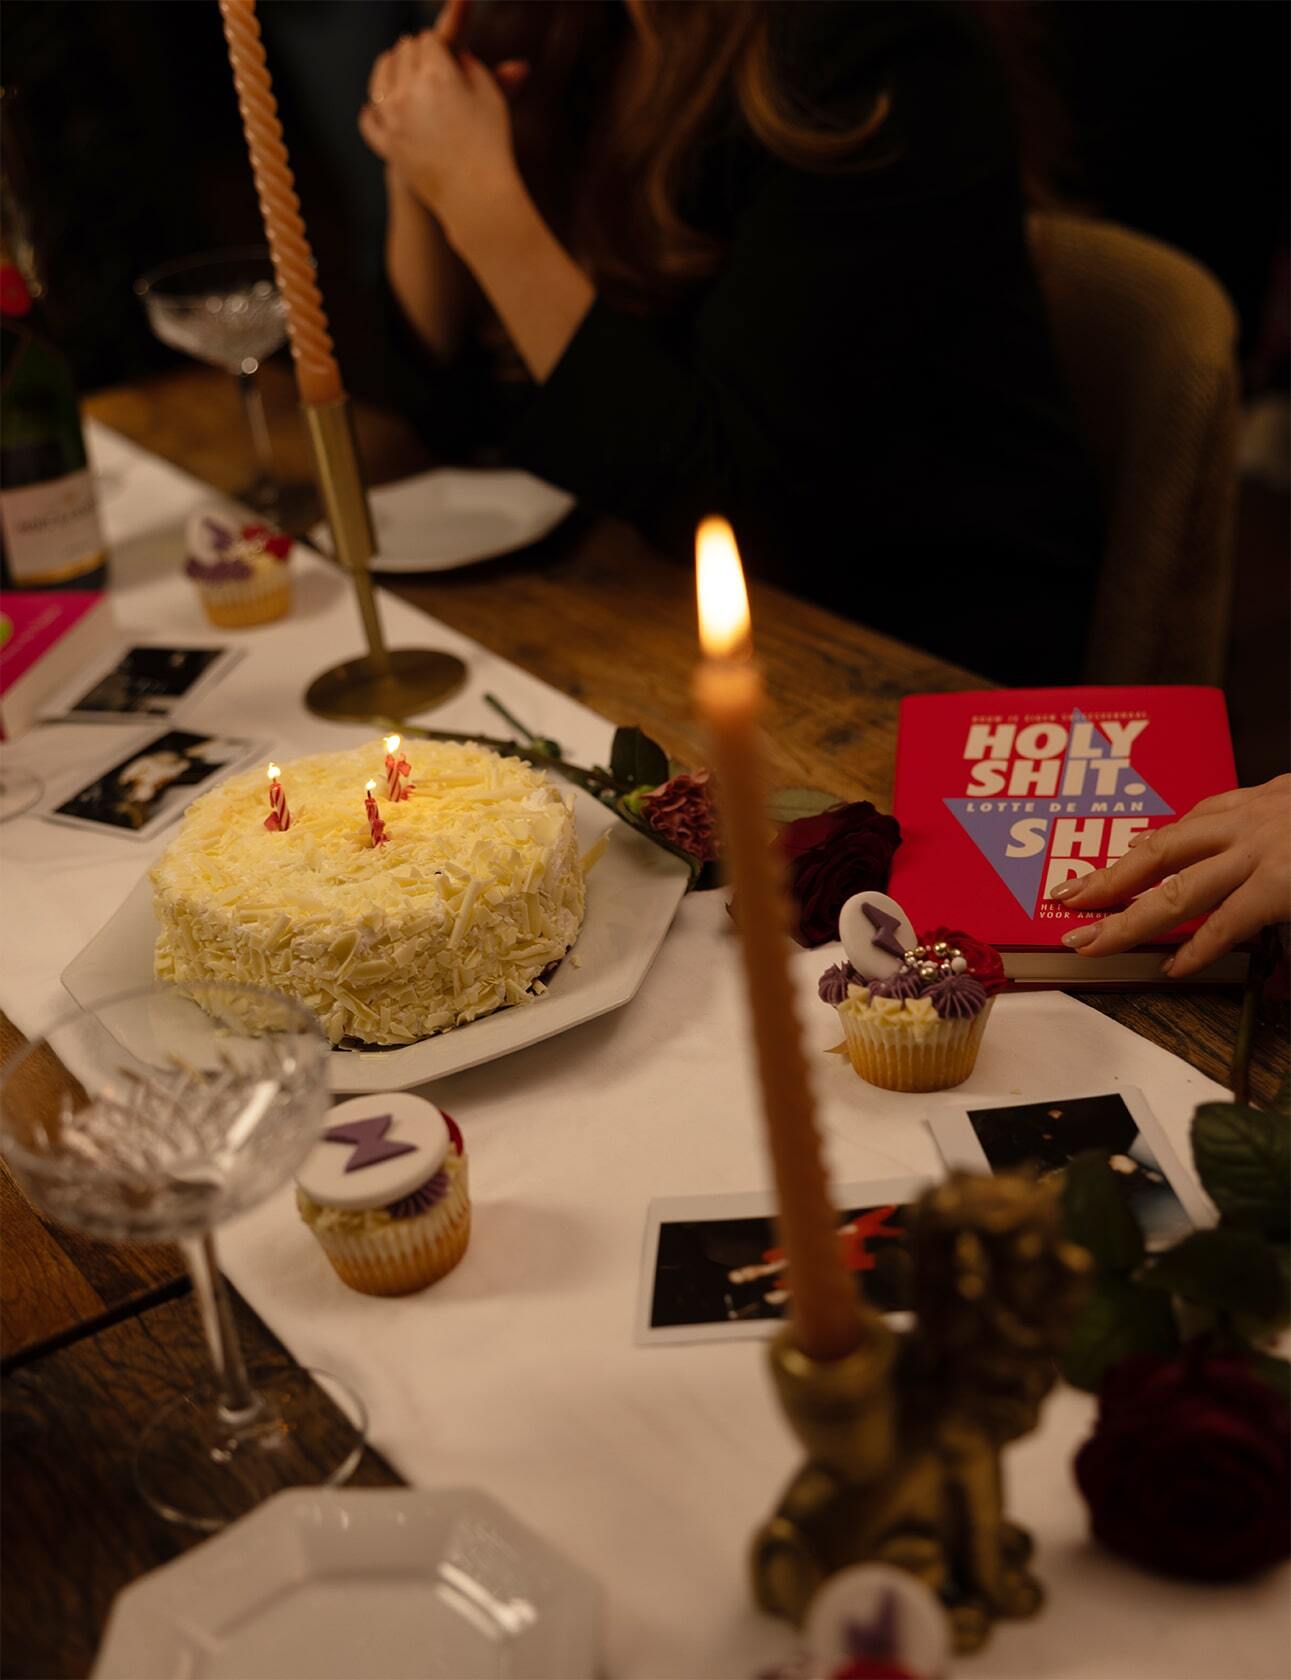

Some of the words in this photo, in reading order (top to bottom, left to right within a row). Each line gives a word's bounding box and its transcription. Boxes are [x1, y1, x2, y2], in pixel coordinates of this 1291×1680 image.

[962, 719, 1150, 760] HOLY
[965, 758, 1146, 797] SHIT.
[966, 802, 1035, 813] LOTTE
[1049, 802, 1077, 813] DE
[1091, 801, 1144, 812] MAN
[1005, 817, 1150, 858] SHE
[1039, 911, 1071, 919] VOOR
